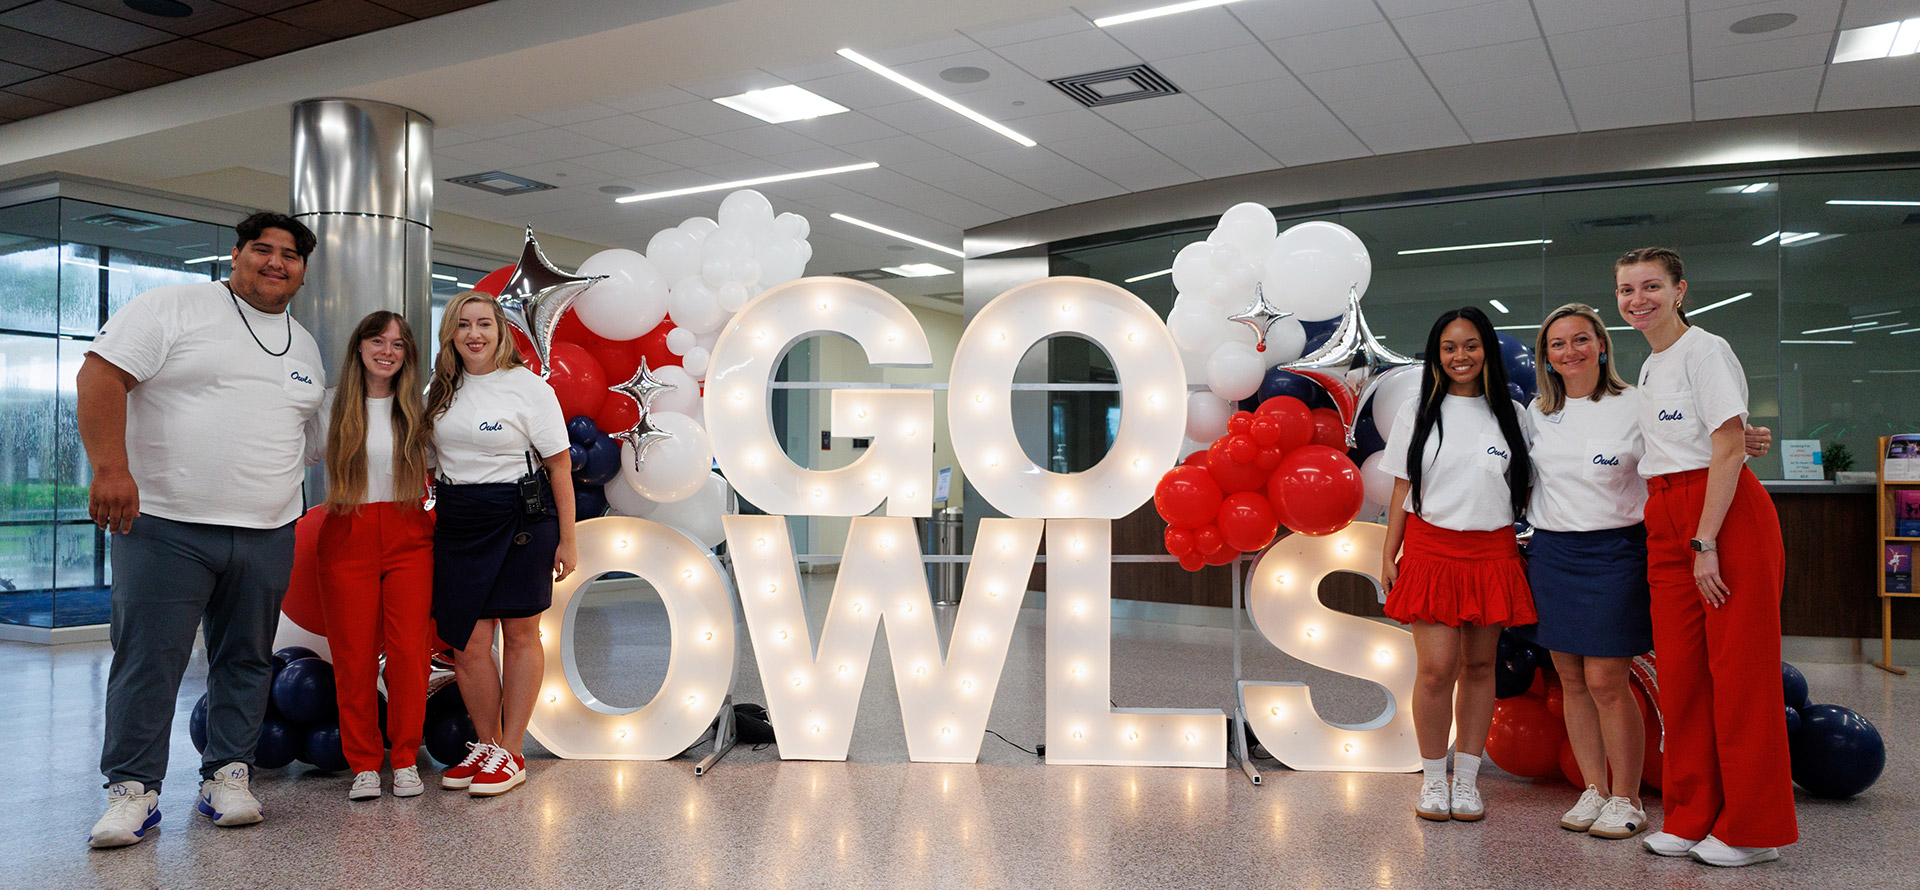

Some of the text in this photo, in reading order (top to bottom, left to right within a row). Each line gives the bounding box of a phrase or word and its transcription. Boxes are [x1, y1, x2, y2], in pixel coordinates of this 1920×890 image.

[290, 371, 313, 385] Owls
[703, 276, 1187, 519] GO
[1658, 409, 1684, 421] Owls
[479, 421, 503, 431] Owls
[1487, 446, 1508, 460] Owls
[1592, 453, 1619, 466] Owls
[500, 514, 1457, 773] OWLS
